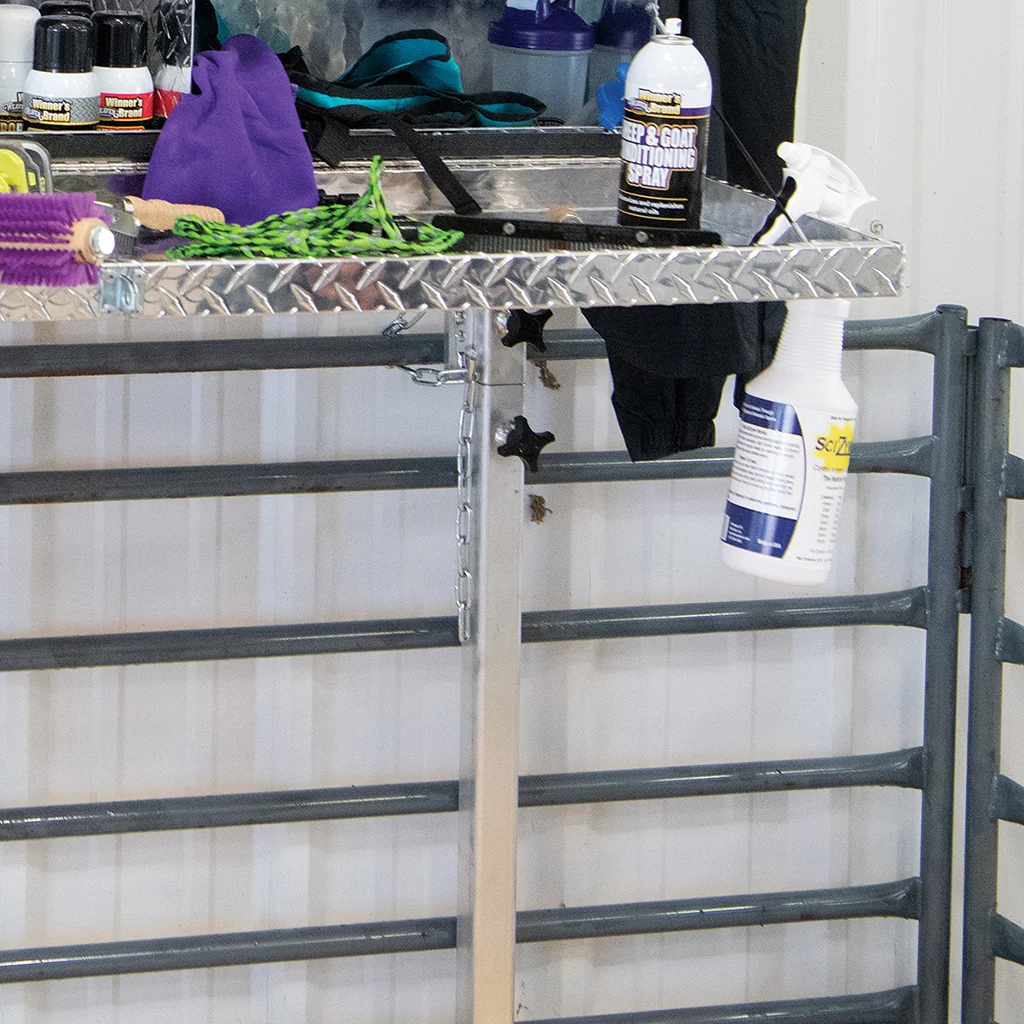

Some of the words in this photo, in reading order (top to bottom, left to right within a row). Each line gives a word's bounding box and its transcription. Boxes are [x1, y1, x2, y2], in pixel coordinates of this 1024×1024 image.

[32, 97, 71, 111] Winner's
[105, 96, 143, 107] Winner's
[42, 110, 70, 122] Brand
[118, 107, 143, 118] Brand
[646, 125, 659, 146] &
[661, 127, 696, 147] GOAT
[628, 163, 670, 188] SPRAY
